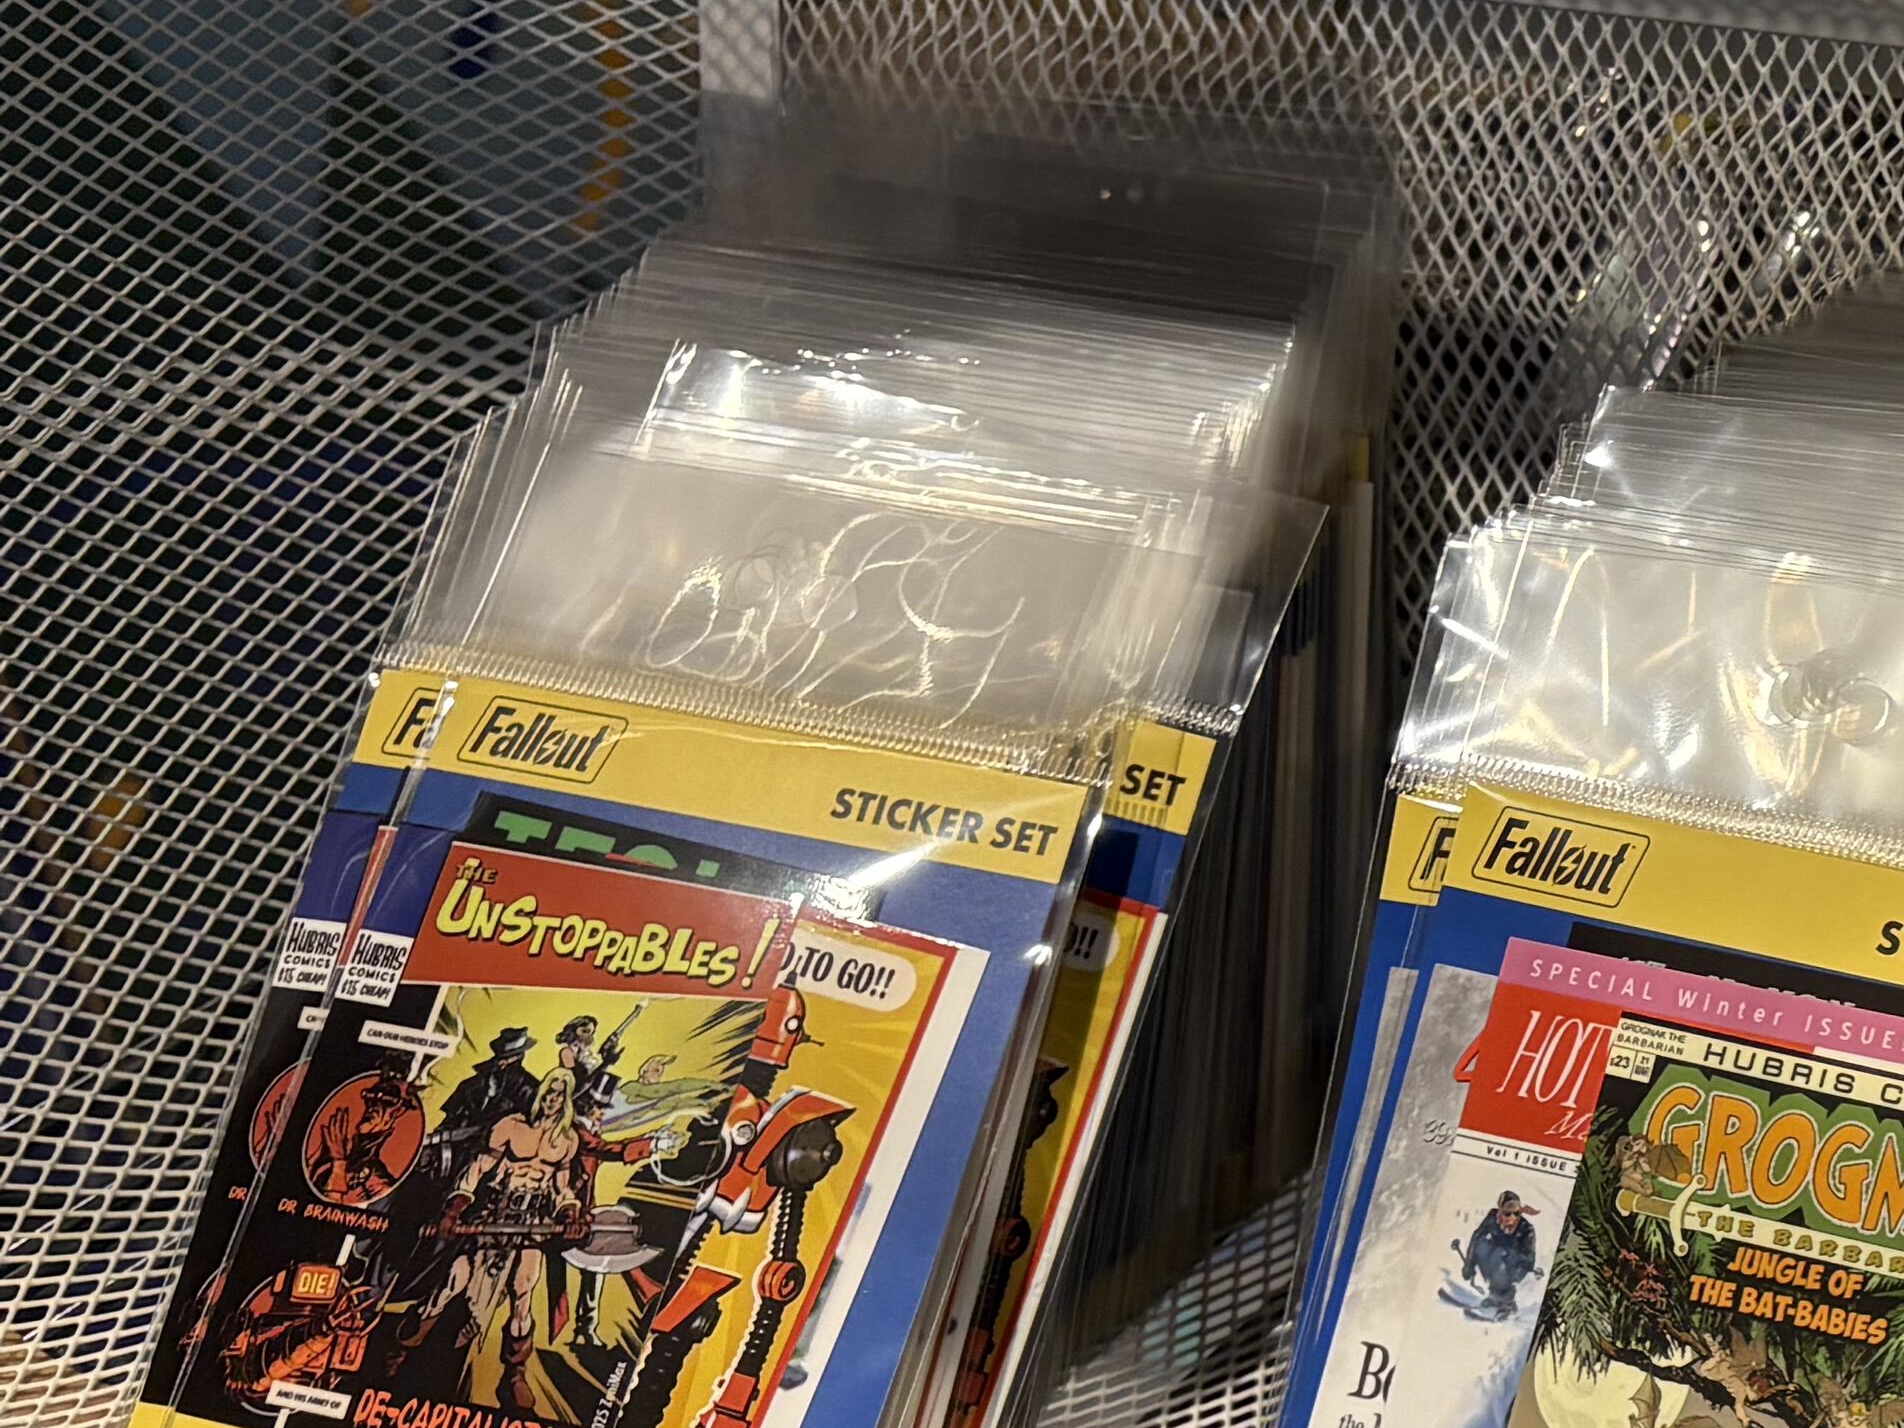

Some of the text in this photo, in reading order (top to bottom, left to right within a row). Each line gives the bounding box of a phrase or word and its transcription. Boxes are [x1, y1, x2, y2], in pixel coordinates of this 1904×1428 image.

[469, 704, 611, 773] Fallout
[1118, 763, 1188, 807] SET
[829, 786, 1060, 857] STICKER SET
[456, 857, 497, 883] THE
[1483, 817, 1630, 896] Fallout
[283, 954, 331, 969] COMICS
[286, 922, 341, 957] HUBRIS
[351, 933, 408, 971] HUBRIS
[348, 966, 396, 984] COMICS
[801, 946, 834, 982] TO
[837, 957, 897, 1000] GO!!
[1530, 958, 1653, 1002] SPECIAL
[1677, 987, 1784, 1028] Winter
[1495, 1009, 1614, 1109] HOT
[1616, 1034, 1685, 1056] BARBARIAN
[1703, 1041, 1857, 1094] HUBRIS
[278, 1198, 389, 1232] DR BRAINWASH
[1696, 1209, 1756, 1239] THE
[299, 1272, 336, 1295] DIE!
[1727, 1246, 1866, 1300] JUNGLE OF
[1688, 1274, 1889, 1345] THE BAT-BABIES
